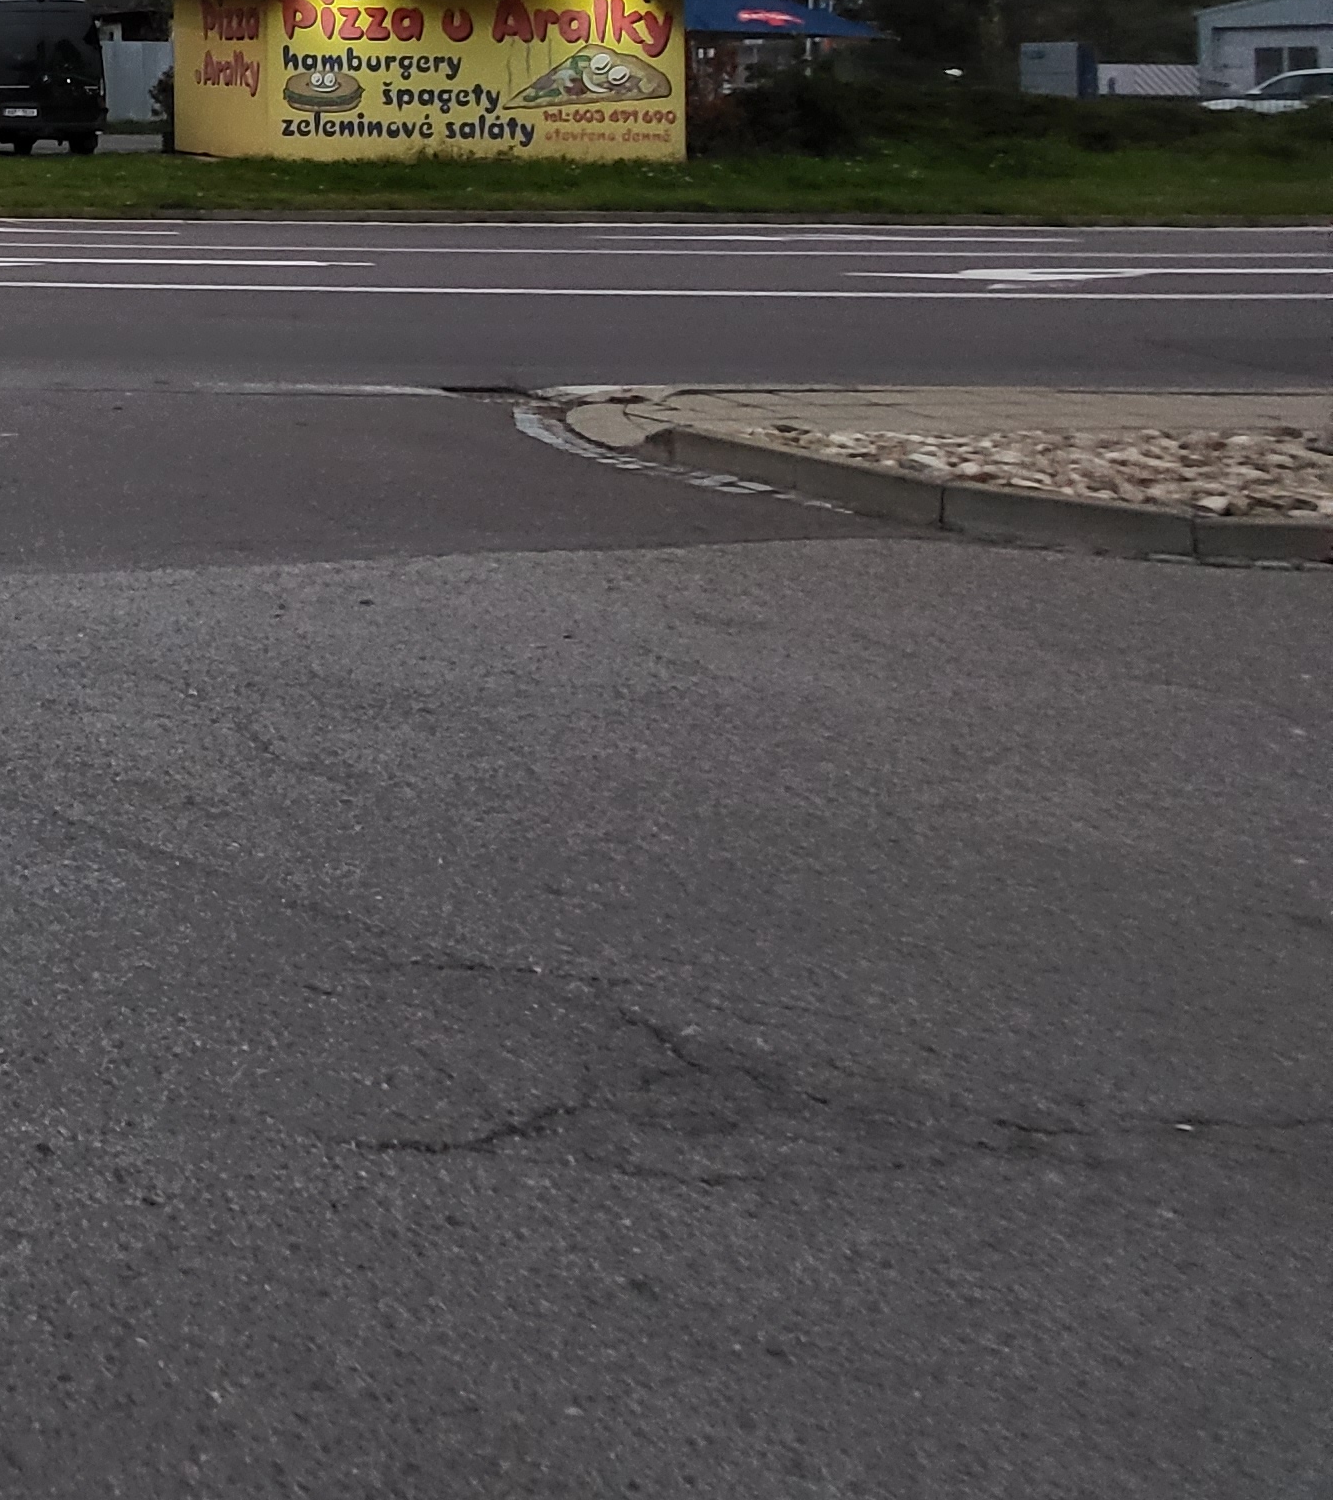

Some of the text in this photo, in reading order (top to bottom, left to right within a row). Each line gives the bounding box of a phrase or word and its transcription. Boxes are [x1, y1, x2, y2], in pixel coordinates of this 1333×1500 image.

[441, 7, 474, 43] u
[204, 49, 260, 97] Aralky
[282, 45, 462, 81] hamburgery
[382, 82, 501, 115] špagety
[281, 112, 535, 148] zeleninové saláty
